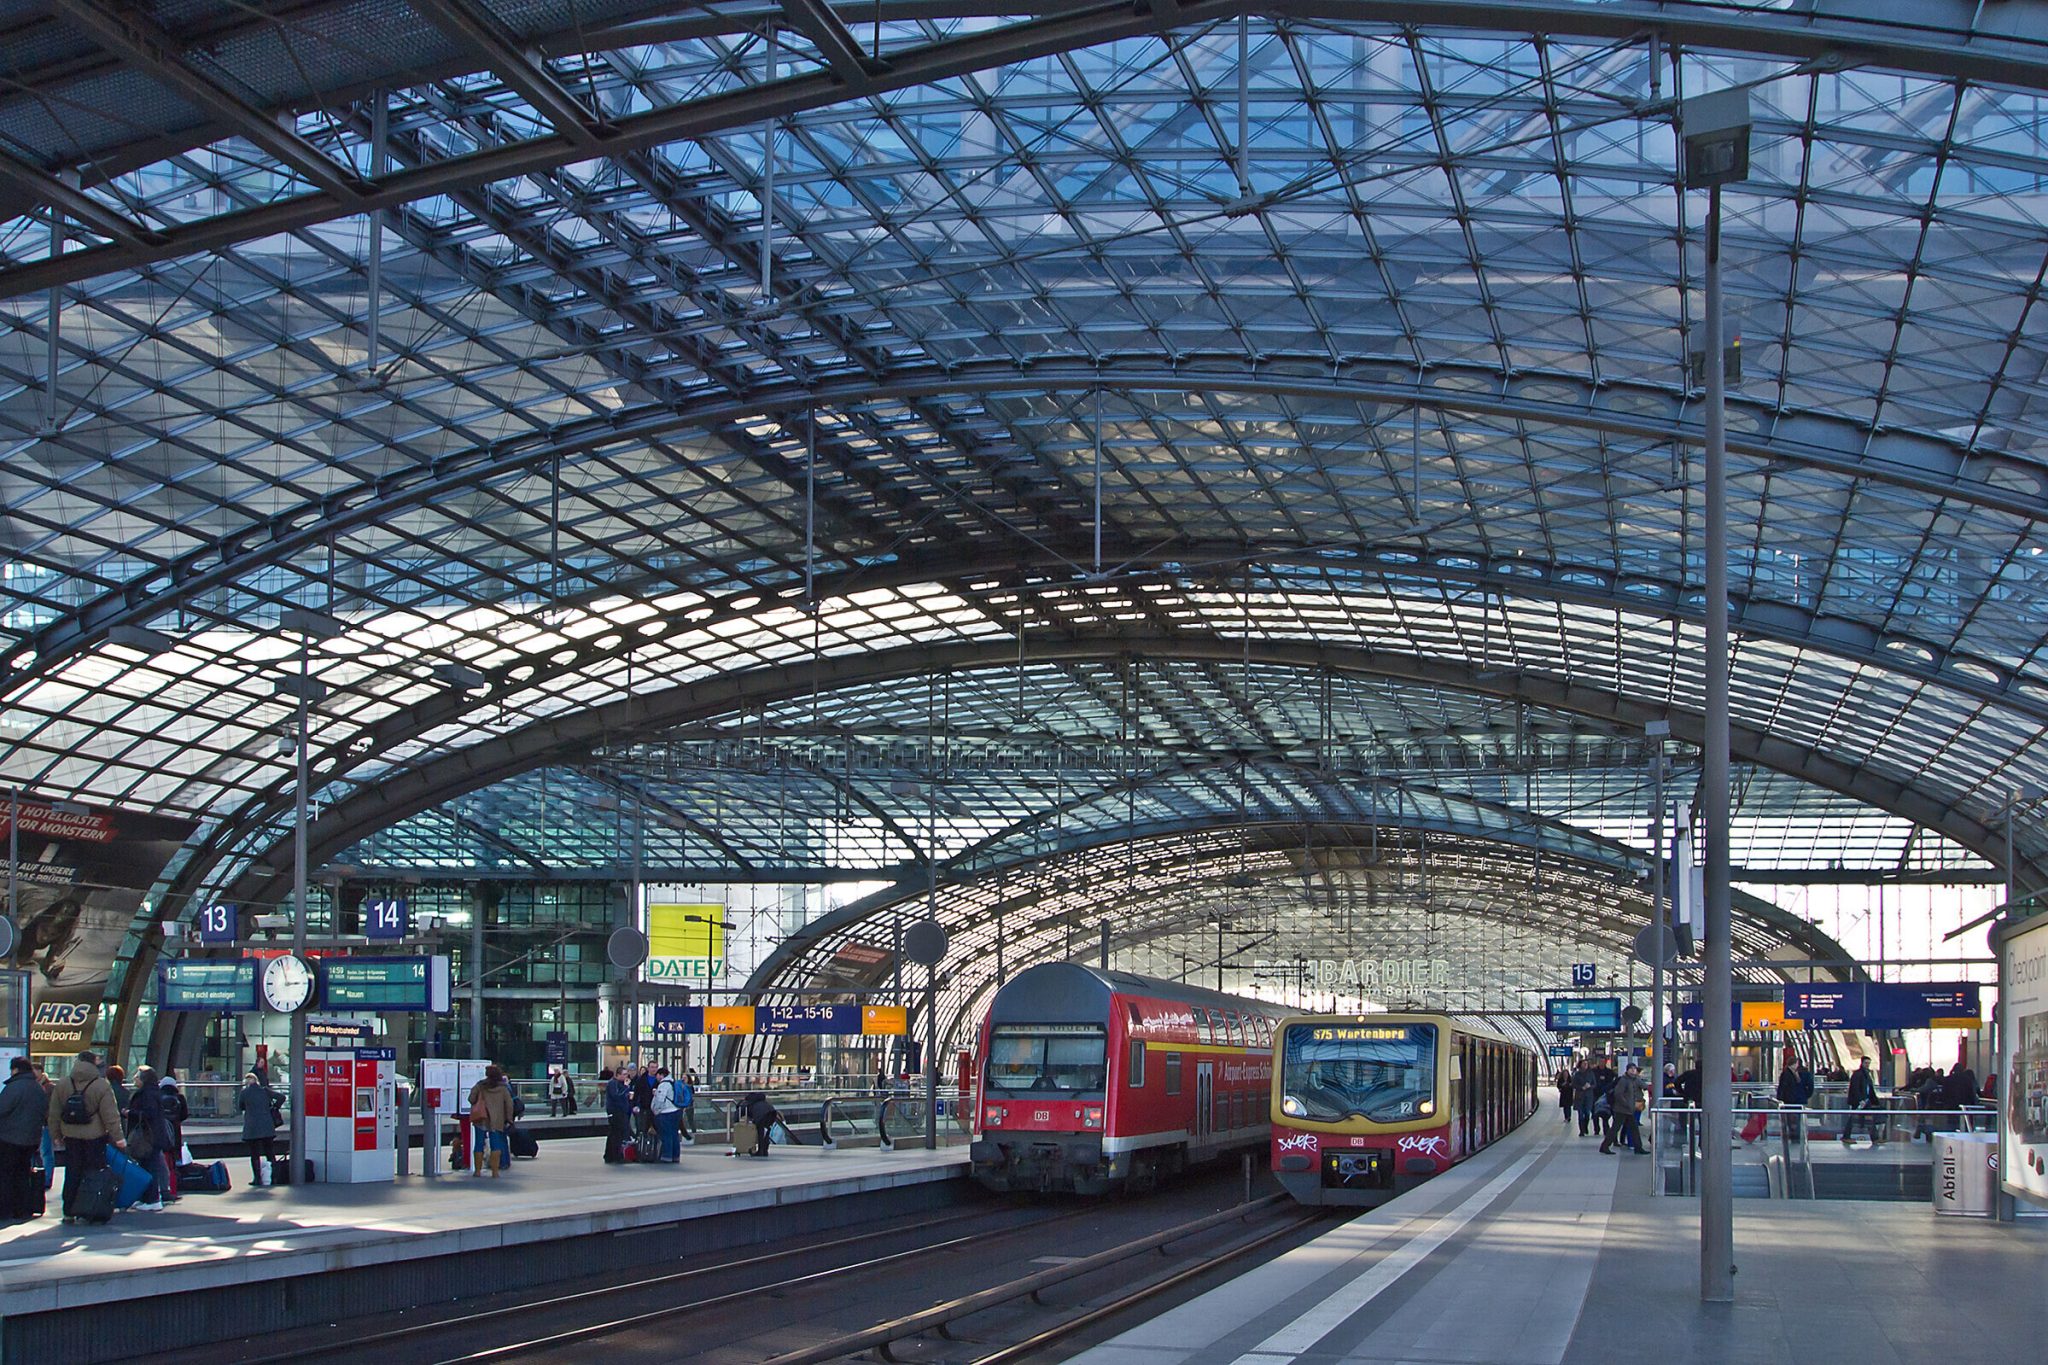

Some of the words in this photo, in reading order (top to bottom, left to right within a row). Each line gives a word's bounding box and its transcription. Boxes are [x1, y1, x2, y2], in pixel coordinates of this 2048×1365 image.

[39, 822, 108, 840] MONSTERN
[40, 865, 76, 876] UNSERE
[204, 905, 227, 932] 13
[374, 901, 399, 928] 14
[167, 967, 178, 979] 13
[412, 964, 425, 978] 14
[649, 959, 723, 977] DATEV
[1254, 959, 1449, 984] BOMBARDIER
[1573, 964, 1593, 981] 15
[1386, 985, 1429, 996] Berlin
[34, 1002, 91, 1026] HRS
[770, 1006, 793, 1019] 1-12
[804, 1006, 833, 1019] 15-16
[1313, 1028, 1333, 1040] S75
[1337, 1028, 1405, 1040] Wartenberg
[1403, 1101, 1412, 1113] 2
[1035, 1111, 1048, 1121] DB
[1942, 1157, 1956, 1201] Abfall
